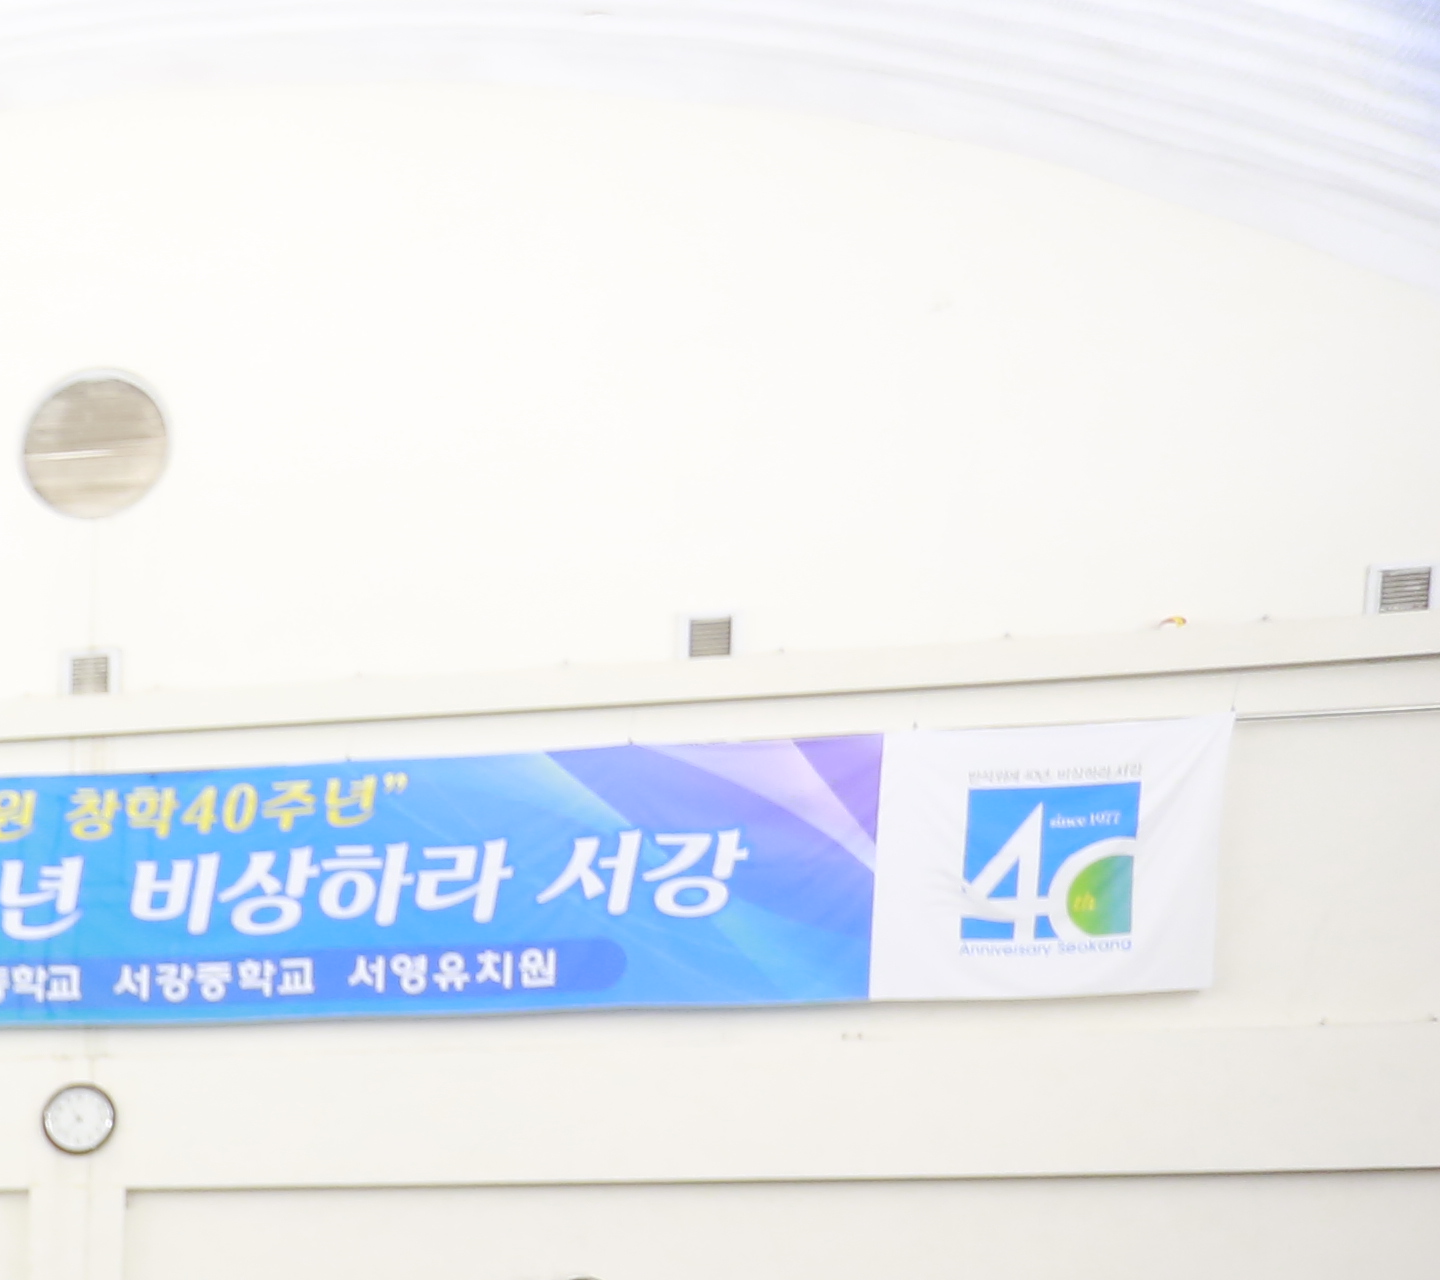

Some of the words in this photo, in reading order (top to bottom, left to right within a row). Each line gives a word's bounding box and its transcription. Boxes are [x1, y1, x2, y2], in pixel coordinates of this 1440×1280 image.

[129, 838, 514, 936] 비상하라
[536, 828, 749, 918] 서강
[113, 957, 316, 1003] 서강중학교
[347, 947, 557, 995] 서영유치원
